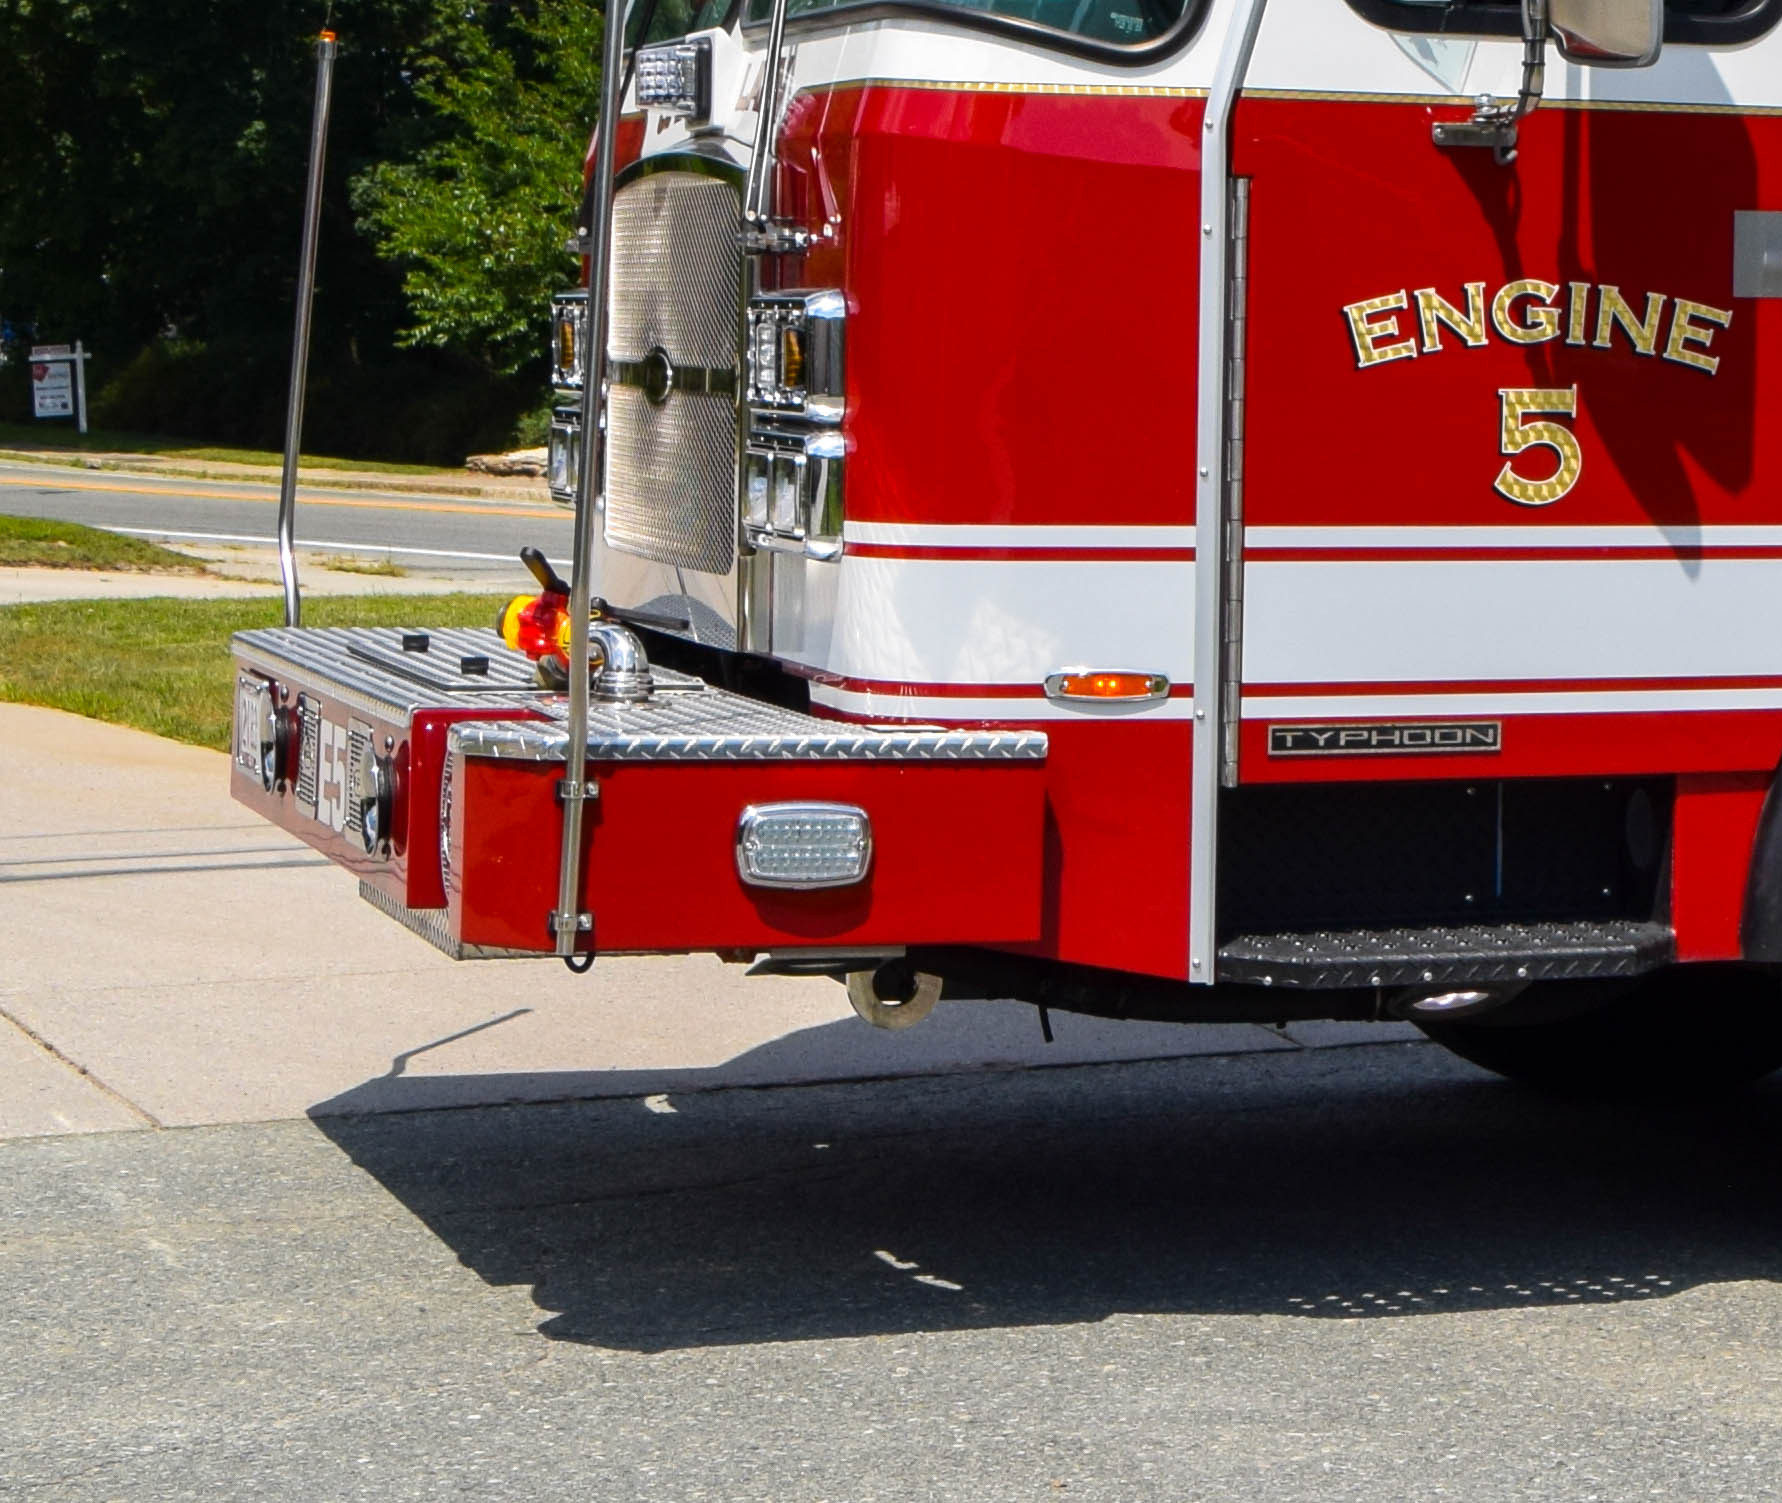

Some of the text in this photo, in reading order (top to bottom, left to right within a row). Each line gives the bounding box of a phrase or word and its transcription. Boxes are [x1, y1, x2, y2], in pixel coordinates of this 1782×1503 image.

[1341, 279, 1733, 376] ENGINE
[1494, 383, 1583, 506] 5
[317, 718, 348, 833] E5
[1273, 725, 1497, 748] TYPHOON
